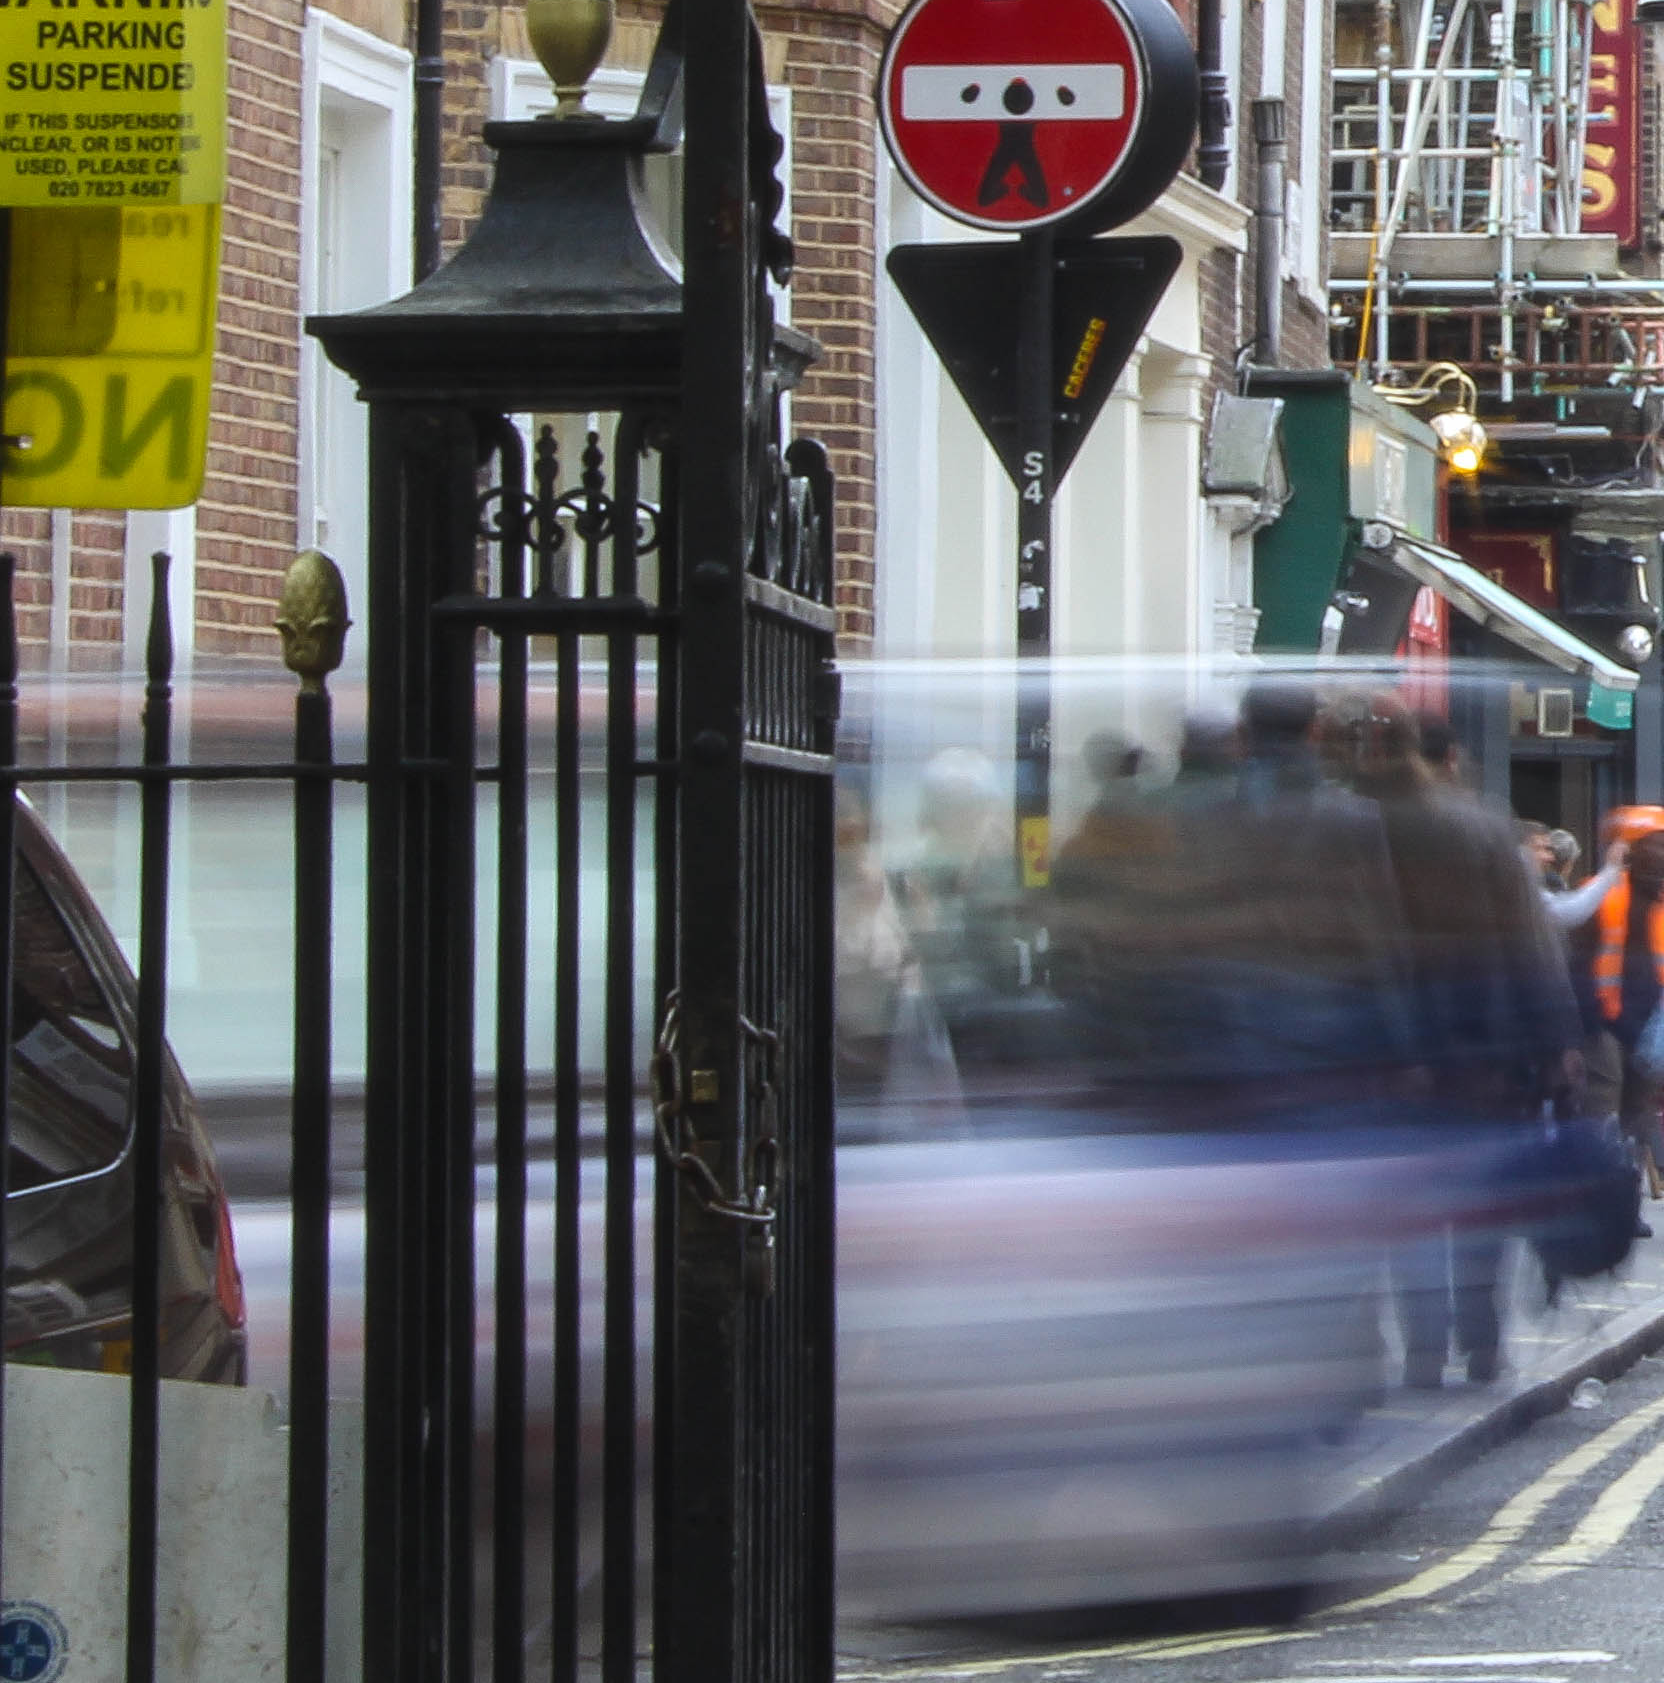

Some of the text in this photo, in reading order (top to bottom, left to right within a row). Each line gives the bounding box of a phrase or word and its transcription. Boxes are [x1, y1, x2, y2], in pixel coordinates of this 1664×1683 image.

[37, 21, 185, 49] PARKING
[28, 114, 68, 130] THIS
[82, 136, 109, 152] OR
[115, 136, 130, 152] IS
[137, 136, 174, 152] NOT
[15, 158, 70, 176] USED,
[77, 158, 149, 175] PLEASE
